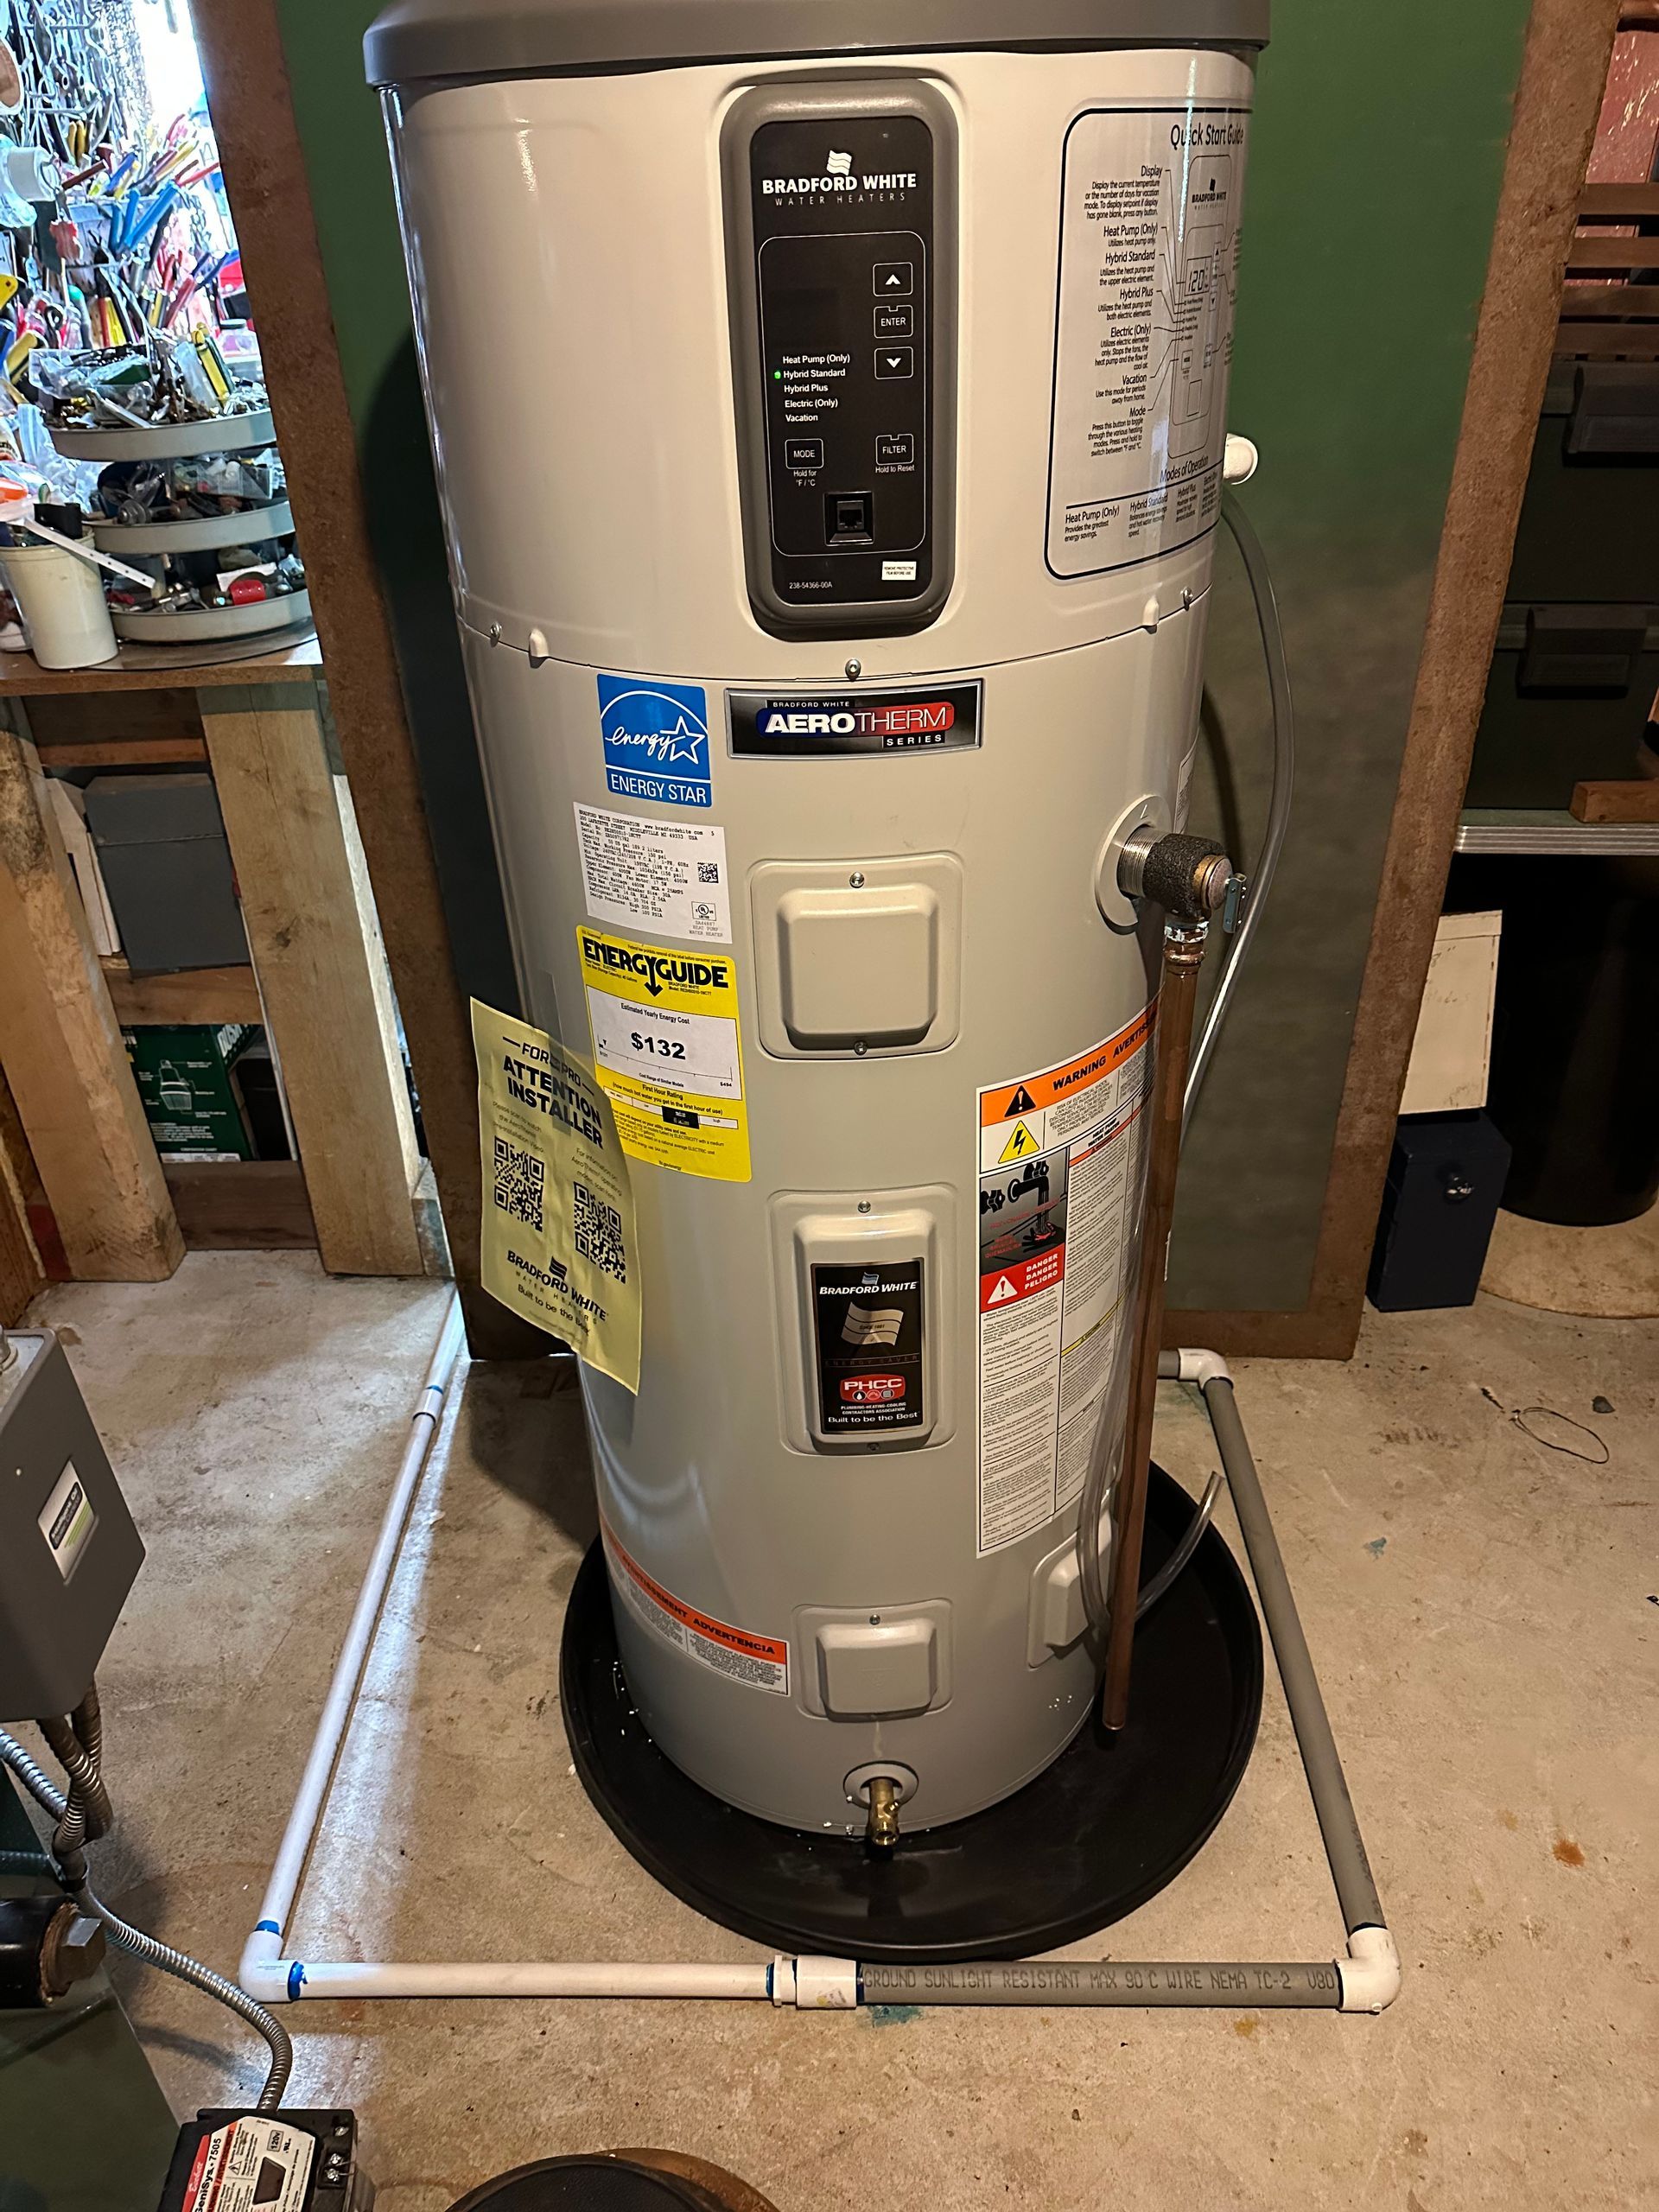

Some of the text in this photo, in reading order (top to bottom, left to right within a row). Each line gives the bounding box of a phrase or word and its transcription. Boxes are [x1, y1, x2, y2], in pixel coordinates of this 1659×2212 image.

[1205, 124, 1226, 145] Start
[1227, 124, 1244, 145] Guide
[1141, 165, 1162, 178] Display
[762, 174, 916, 194] BRADFORD WHITE
[1092, 181, 1109, 190] Display
[1119, 180, 1134, 188] current
[1135, 180, 1160, 188] temperature
[776, 192, 906, 207] WATER HEATERS
[1104, 223, 1158, 238] Heat Pump (Only)
[1106, 249, 1155, 266] Hybrid Standard
[1188, 269, 1205, 292] 120
[1120, 287, 1153, 302] Hybrid Plus
[880, 317, 906, 327] ENTER
[1111, 323, 1151, 337] Electric (Only)
[783, 354, 850, 365] Heat Pump (Only)
[783, 368, 845, 379] Hybrid Standard
[1122, 374, 1147, 385] Vacation
[784, 384, 828, 394] Hybrid Plus
[785, 398, 838, 408] Electric (Only)
[1129, 406, 1146, 416] Mode
[1088, 432, 1105, 441] through
[793, 449, 815, 458] MODE
[882, 445, 906, 454] FILTER
[1160, 454, 1208, 482] Modes of Operation
[1130, 493, 1168, 512] Hybrid Standard
[1065, 505, 1120, 524] Heat Pump (Only)
[1065, 524, 1083, 534] Provides
[1092, 520, 1109, 529] greatest
[766, 709, 947, 734] AEROTHERM
[605, 727, 674, 760] energy
[887, 734, 942, 747] SERIES
[611, 774, 707, 804] ENERGY STAR
[582, 937, 728, 989] ENERGYGUIDE
[621, 1003, 643, 1015] Estimated
[645, 1010, 658, 1020] Yearly
[659, 1014, 677, 1023] Energy
[522, 1042, 549, 1064] FOR
[631, 1032, 686, 1060] $132
[562, 1063, 581, 1086] PRO
[1052, 1056, 1106, 1091] WARNING
[504, 1055, 601, 1128] ATTENTION
[641, 1092, 653, 1101] water
[654, 1087, 665, 1096] Hour
[667, 1090, 683, 1101] Rating
[508, 1077, 602, 1149] INSTALLER
[1089, 1134, 1103, 1147] WATER
[1093, 1128, 1104, 1138] HEAT
[1026, 1262, 1058, 1281] DANGER
[1027, 1253, 1058, 1273] DANGER
[507, 1249, 606, 1321] BRADFORD WHITE
[819, 1281, 917, 1294] BRADFORD WHITE
[1024, 1269, 1058, 1289] PELIGRO
[518, 1284, 533, 1300] Built
[535, 1296, 543, 1306] to
[546, 1301, 556, 1313] be
[560, 1308, 573, 1320] the
[844, 1378, 902, 1390] PHCC
[693, 1618, 775, 1654] ADVERTENCIA
[865, 1969, 916, 1988] GROUND
[925, 1969, 992, 1988] SUNLIGHT
[1002, 1969, 1080, 1988] RESISTANT
[1090, 1970, 1117, 1987] MAX
[1167, 1971, 1202, 1989] WIRE
[1211, 1972, 1247, 1989] NEMA
[1254, 1972, 1292, 1989] TC-2
[209, 2139, 221, 2160] 7505
